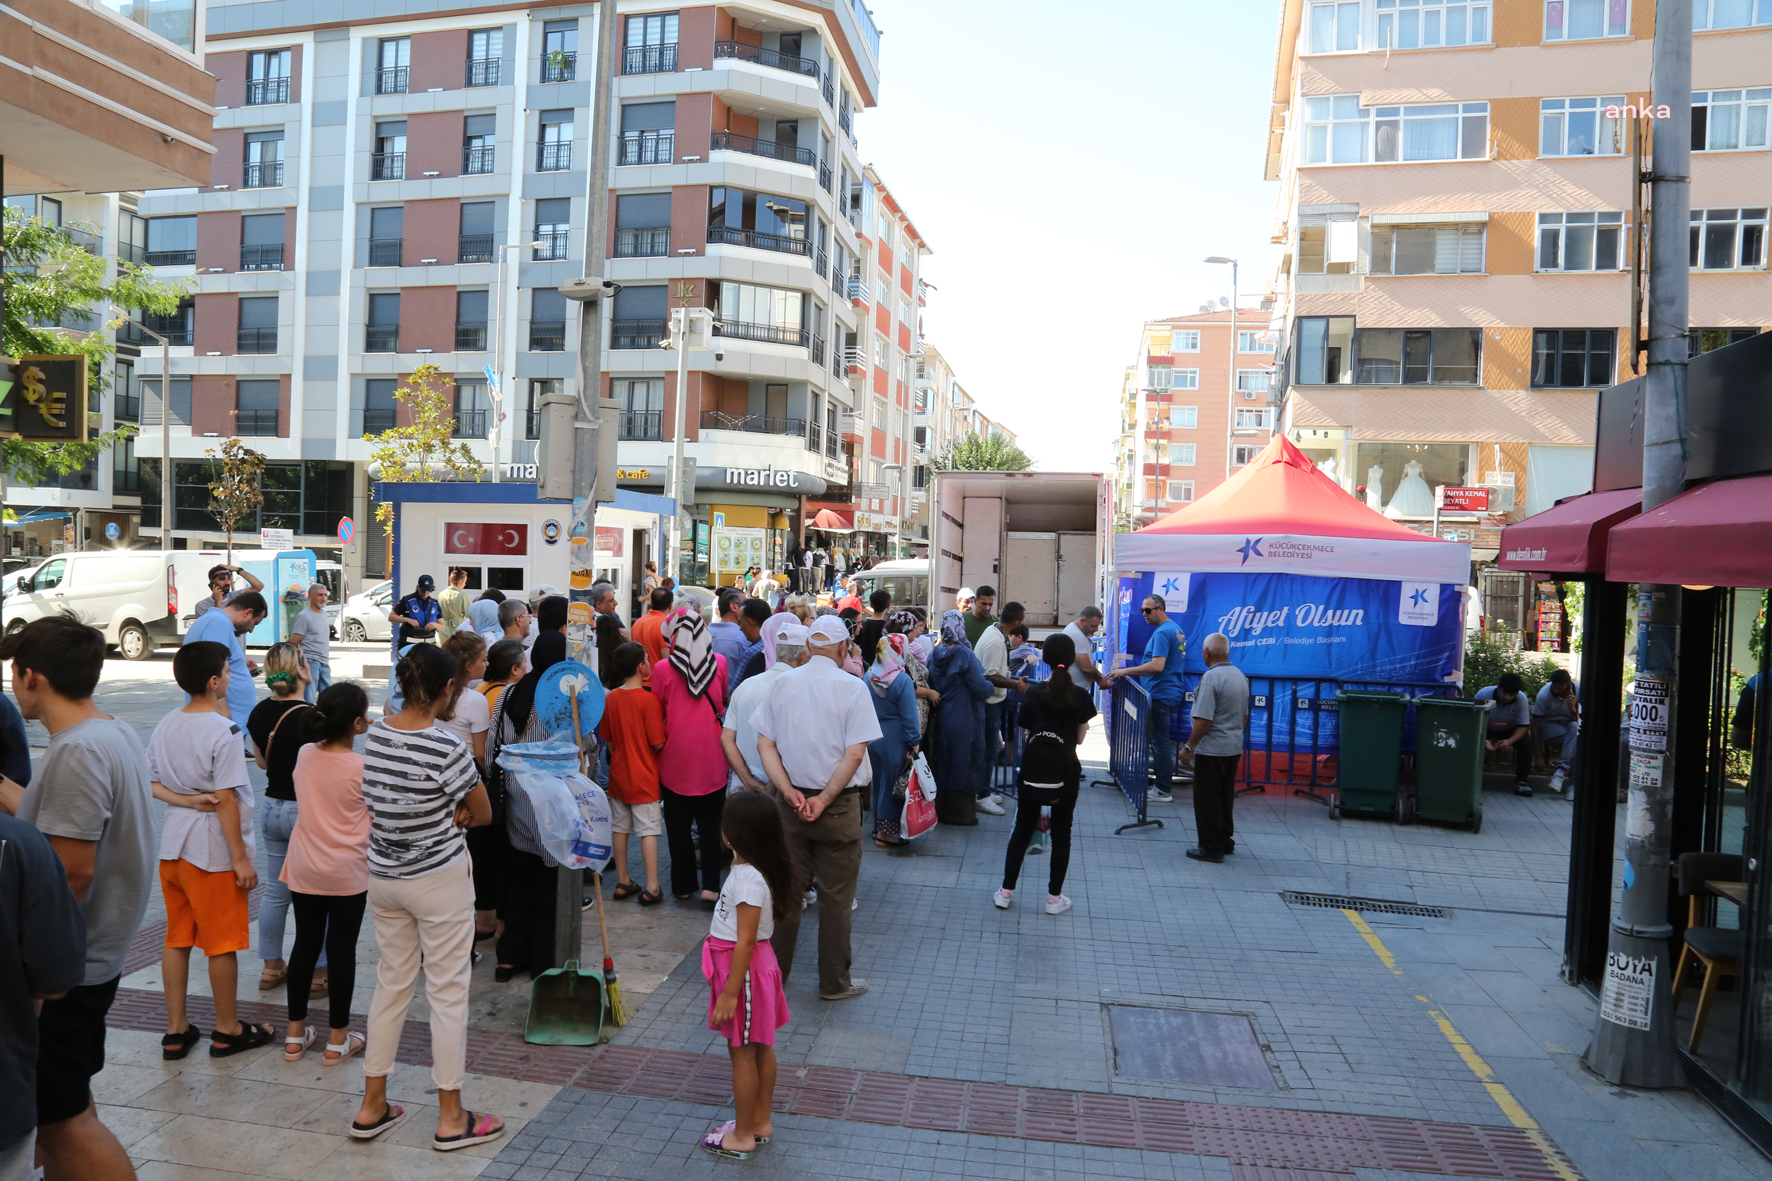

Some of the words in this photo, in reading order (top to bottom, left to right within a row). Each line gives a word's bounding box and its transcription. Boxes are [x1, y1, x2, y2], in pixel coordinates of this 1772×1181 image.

[616, 469, 625, 479] &
[626, 469, 649, 480] cafe
[726, 464, 798, 487] marlet
[1268, 542, 1335, 552] KÜÇÜKÇEKMECE
[1268, 550, 1312, 560] BELEDİYESİ
[1218, 606, 1290, 638] Afiyet
[1295, 604, 1364, 627] Olsun
[1230, 639, 1255, 648] Kemal
[1284, 637, 1314, 646] Belediye
[1316, 636, 1346, 644] Başkanı
[1610, 970, 1644, 985] BADANA
[1614, 1015, 1627, 1023] 963
